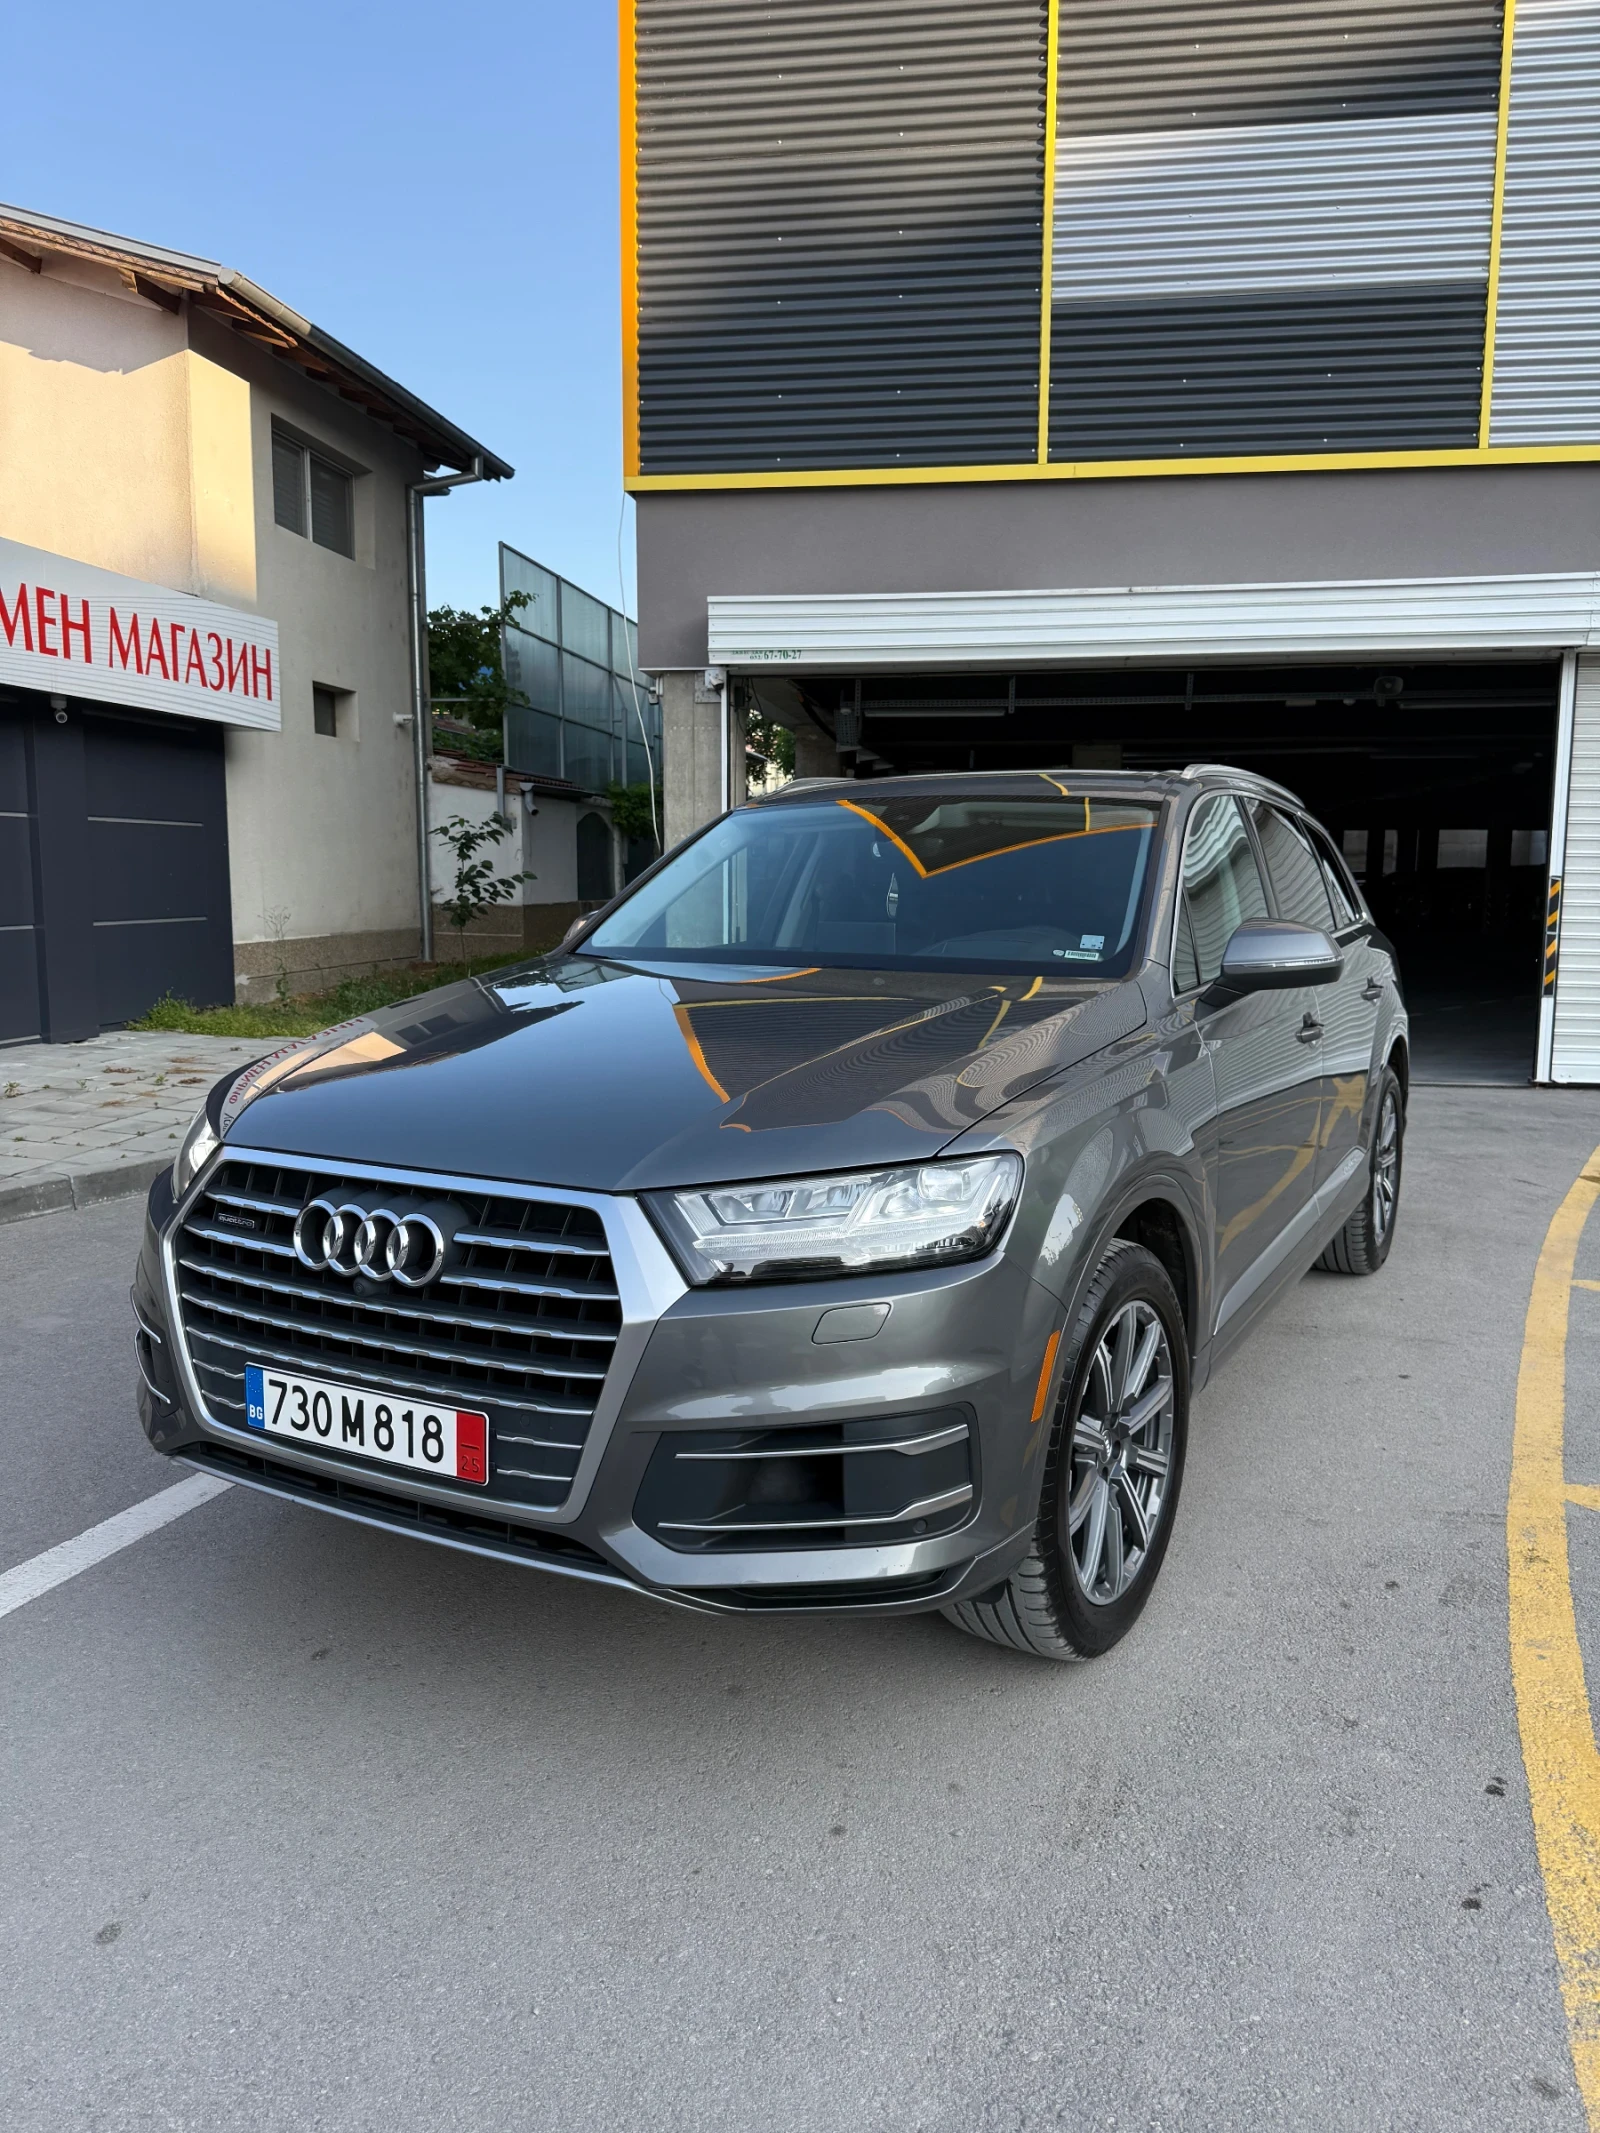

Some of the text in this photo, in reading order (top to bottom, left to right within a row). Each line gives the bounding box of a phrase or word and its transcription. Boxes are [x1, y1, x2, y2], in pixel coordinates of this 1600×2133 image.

[108, 606, 273, 701] МАГАЗИН
[763, 649, 802, 660] 67-70-27
[218, 1215, 253, 1227] quattro
[249, 1404, 263, 1420] BG
[461, 1455, 480, 1474] 25
